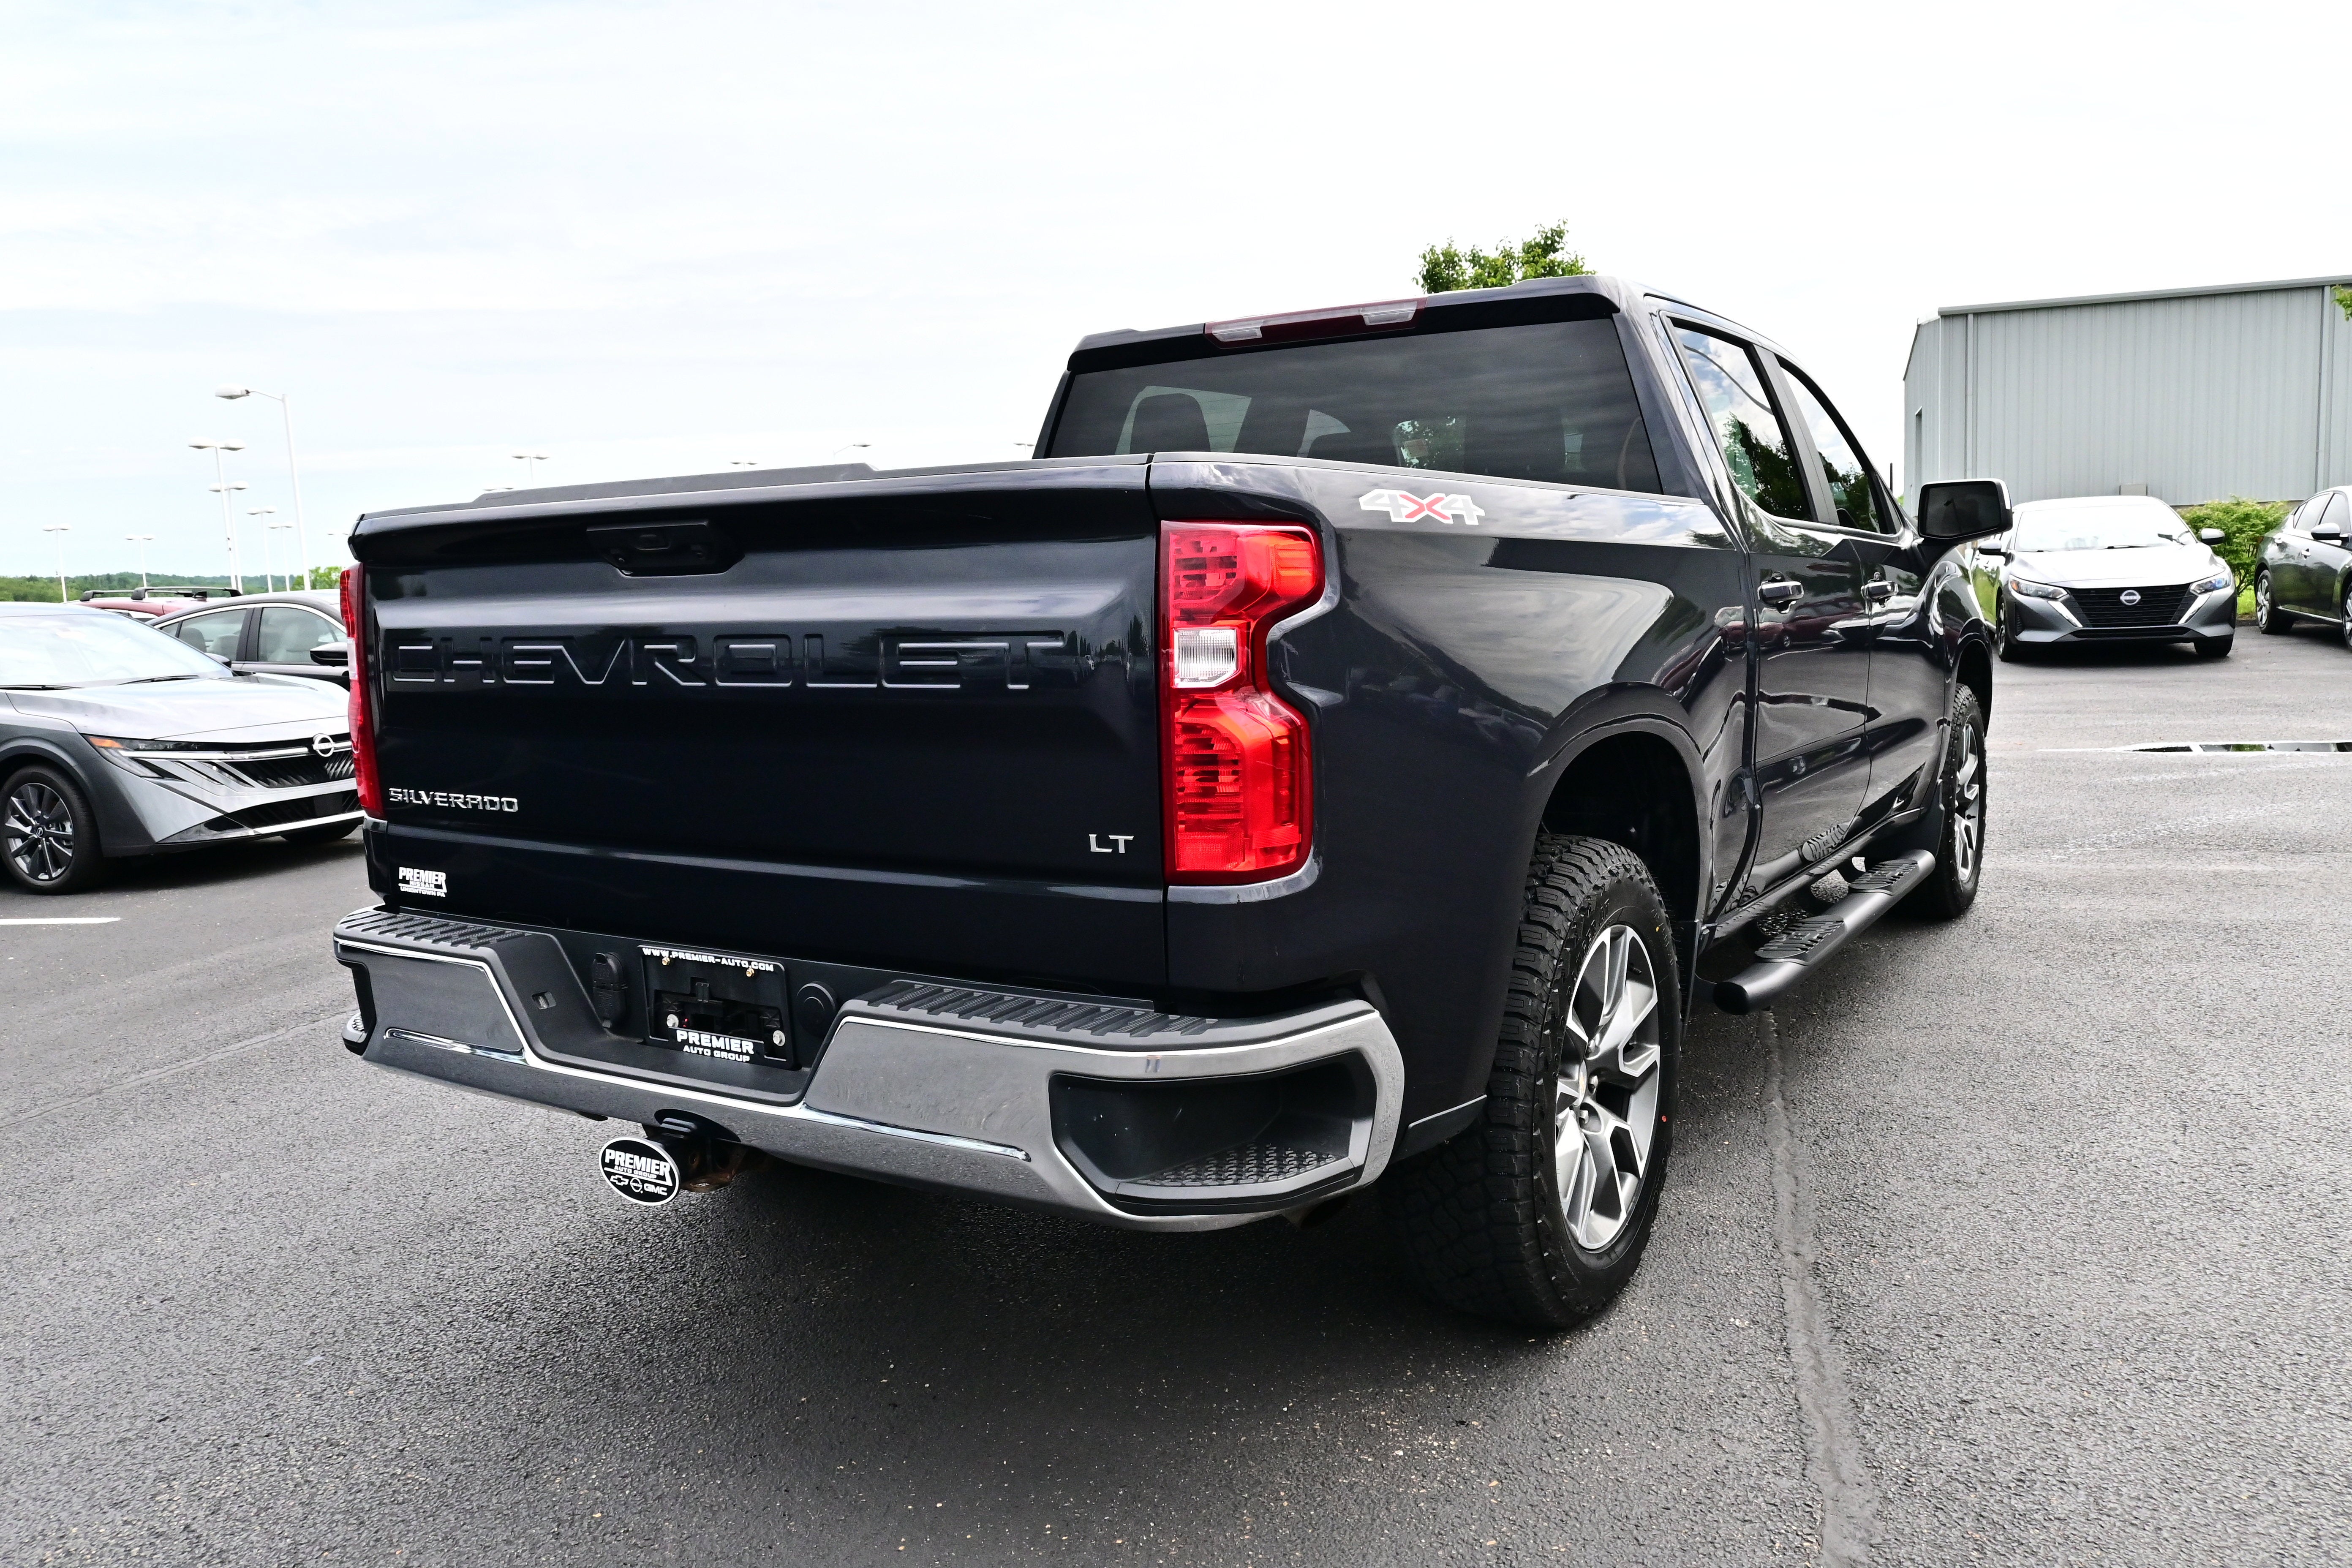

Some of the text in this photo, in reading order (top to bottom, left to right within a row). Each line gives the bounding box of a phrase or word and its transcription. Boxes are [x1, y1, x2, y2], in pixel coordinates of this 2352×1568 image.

[389, 633, 1064, 690] CHEVROLET
[389, 787, 519, 812] SILVERADO
[1089, 833, 1135, 854] LT
[399, 867, 446, 885] PREMIER
[409, 880, 435, 888] NISSAN
[400, 886, 436, 896] UNIONTOWN
[642, 947, 774, 972] WWW.PREMIER-AUTO.COM
[676, 1029, 754, 1054] PREMIER
[683, 1045, 750, 1062] AUTO GROUP
[604, 1149, 672, 1177] PREMIER
[614, 1165, 657, 1179] AUTO GROUP
[643, 1183, 667, 1196] GMC
